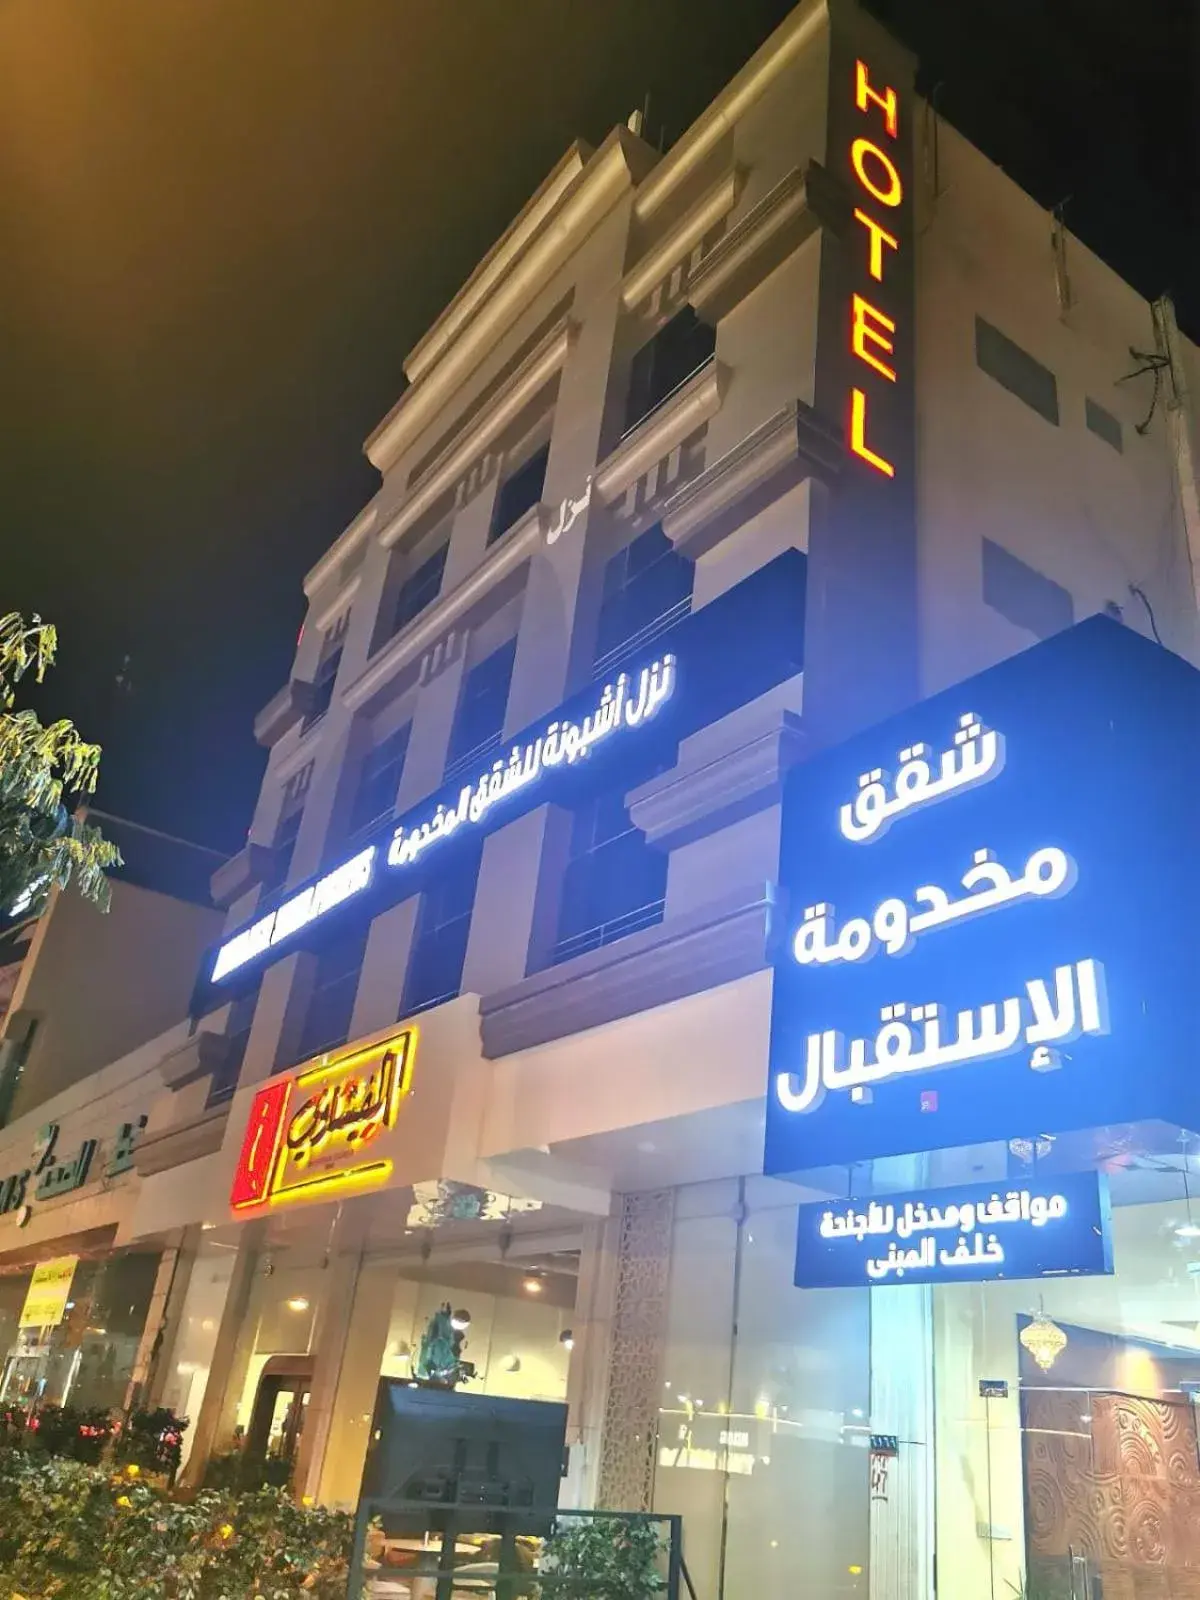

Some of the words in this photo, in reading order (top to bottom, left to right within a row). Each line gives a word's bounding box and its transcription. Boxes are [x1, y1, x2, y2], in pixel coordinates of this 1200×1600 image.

[851, 58, 902, 478] HOTEL
[541, 673, 627, 767] أشبونة
[625, 653, 677, 726] نزل
[468, 739, 541, 823] للشقق
[839, 712, 1002, 843] شقق
[388, 785, 471, 865] المخدومة
[794, 847, 1073, 964] مخدومة
[777, 958, 1107, 1112] الإستقبال
[820, 1202, 894, 1241] للأجنحة
[897, 1202, 975, 1238] ومدخل
[976, 1190, 1068, 1227] مواقف
[866, 1236, 936, 1278] المبنى
[940, 1233, 1005, 1265] خلف
